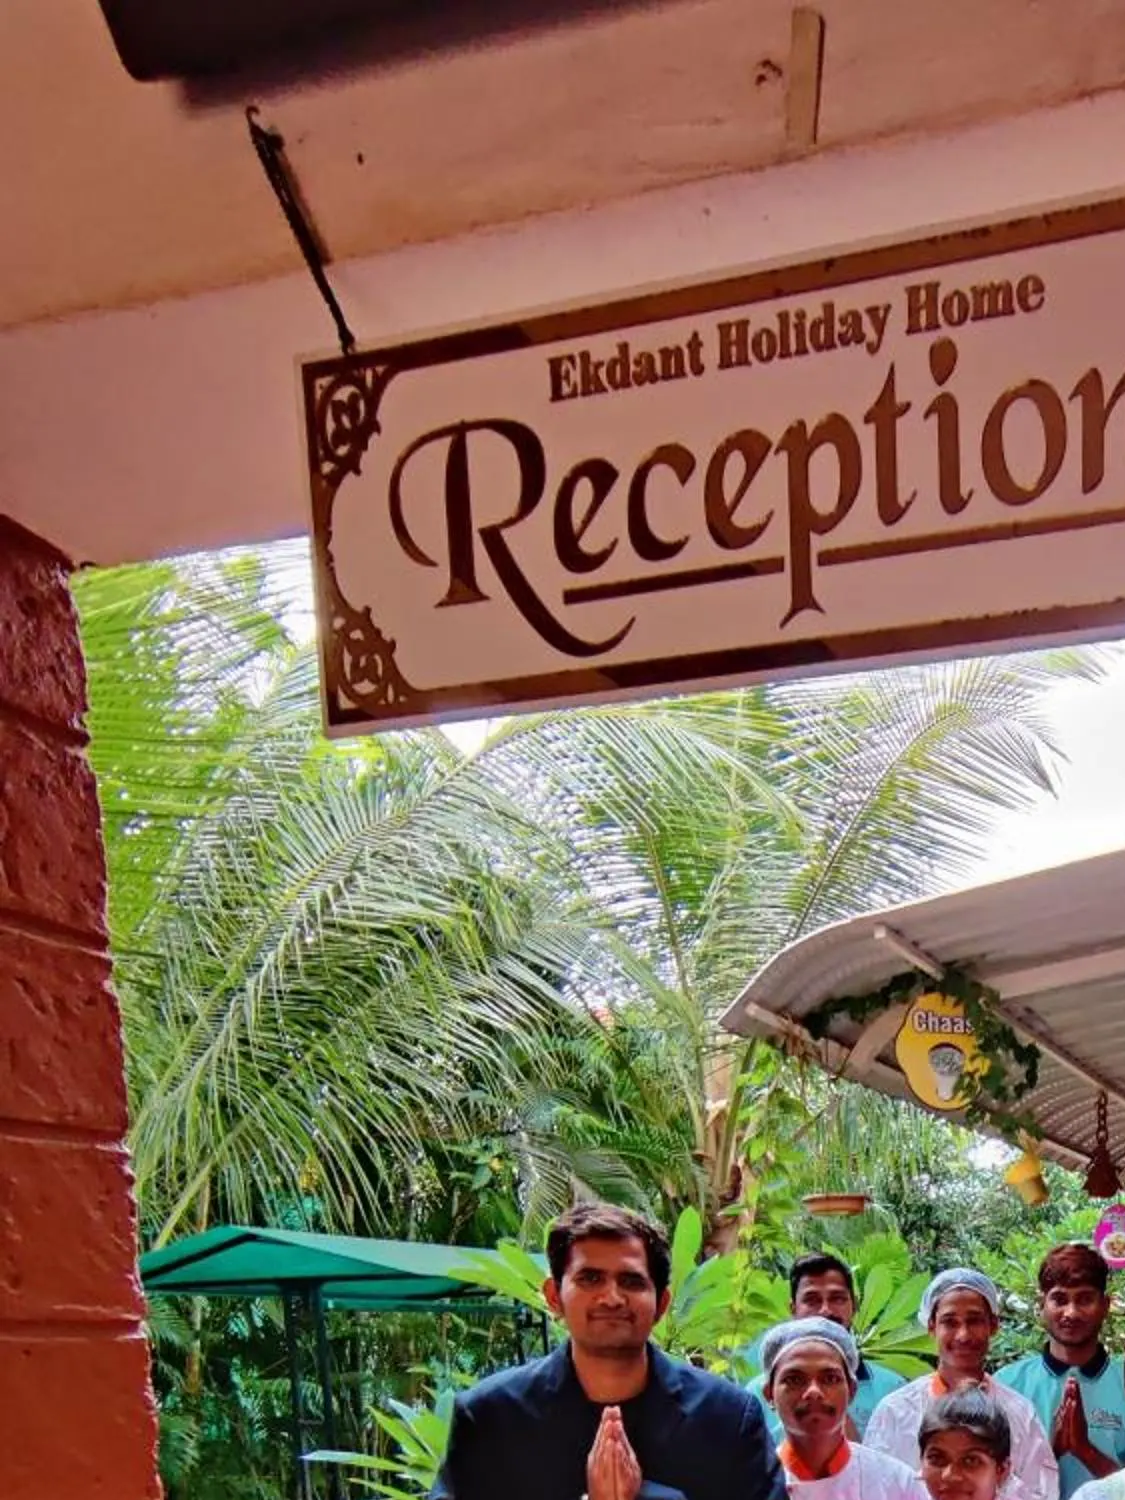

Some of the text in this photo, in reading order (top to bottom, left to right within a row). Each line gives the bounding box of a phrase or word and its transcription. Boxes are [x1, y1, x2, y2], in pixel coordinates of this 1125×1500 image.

[547, 274, 1046, 403] Ekdant Holiday Home
